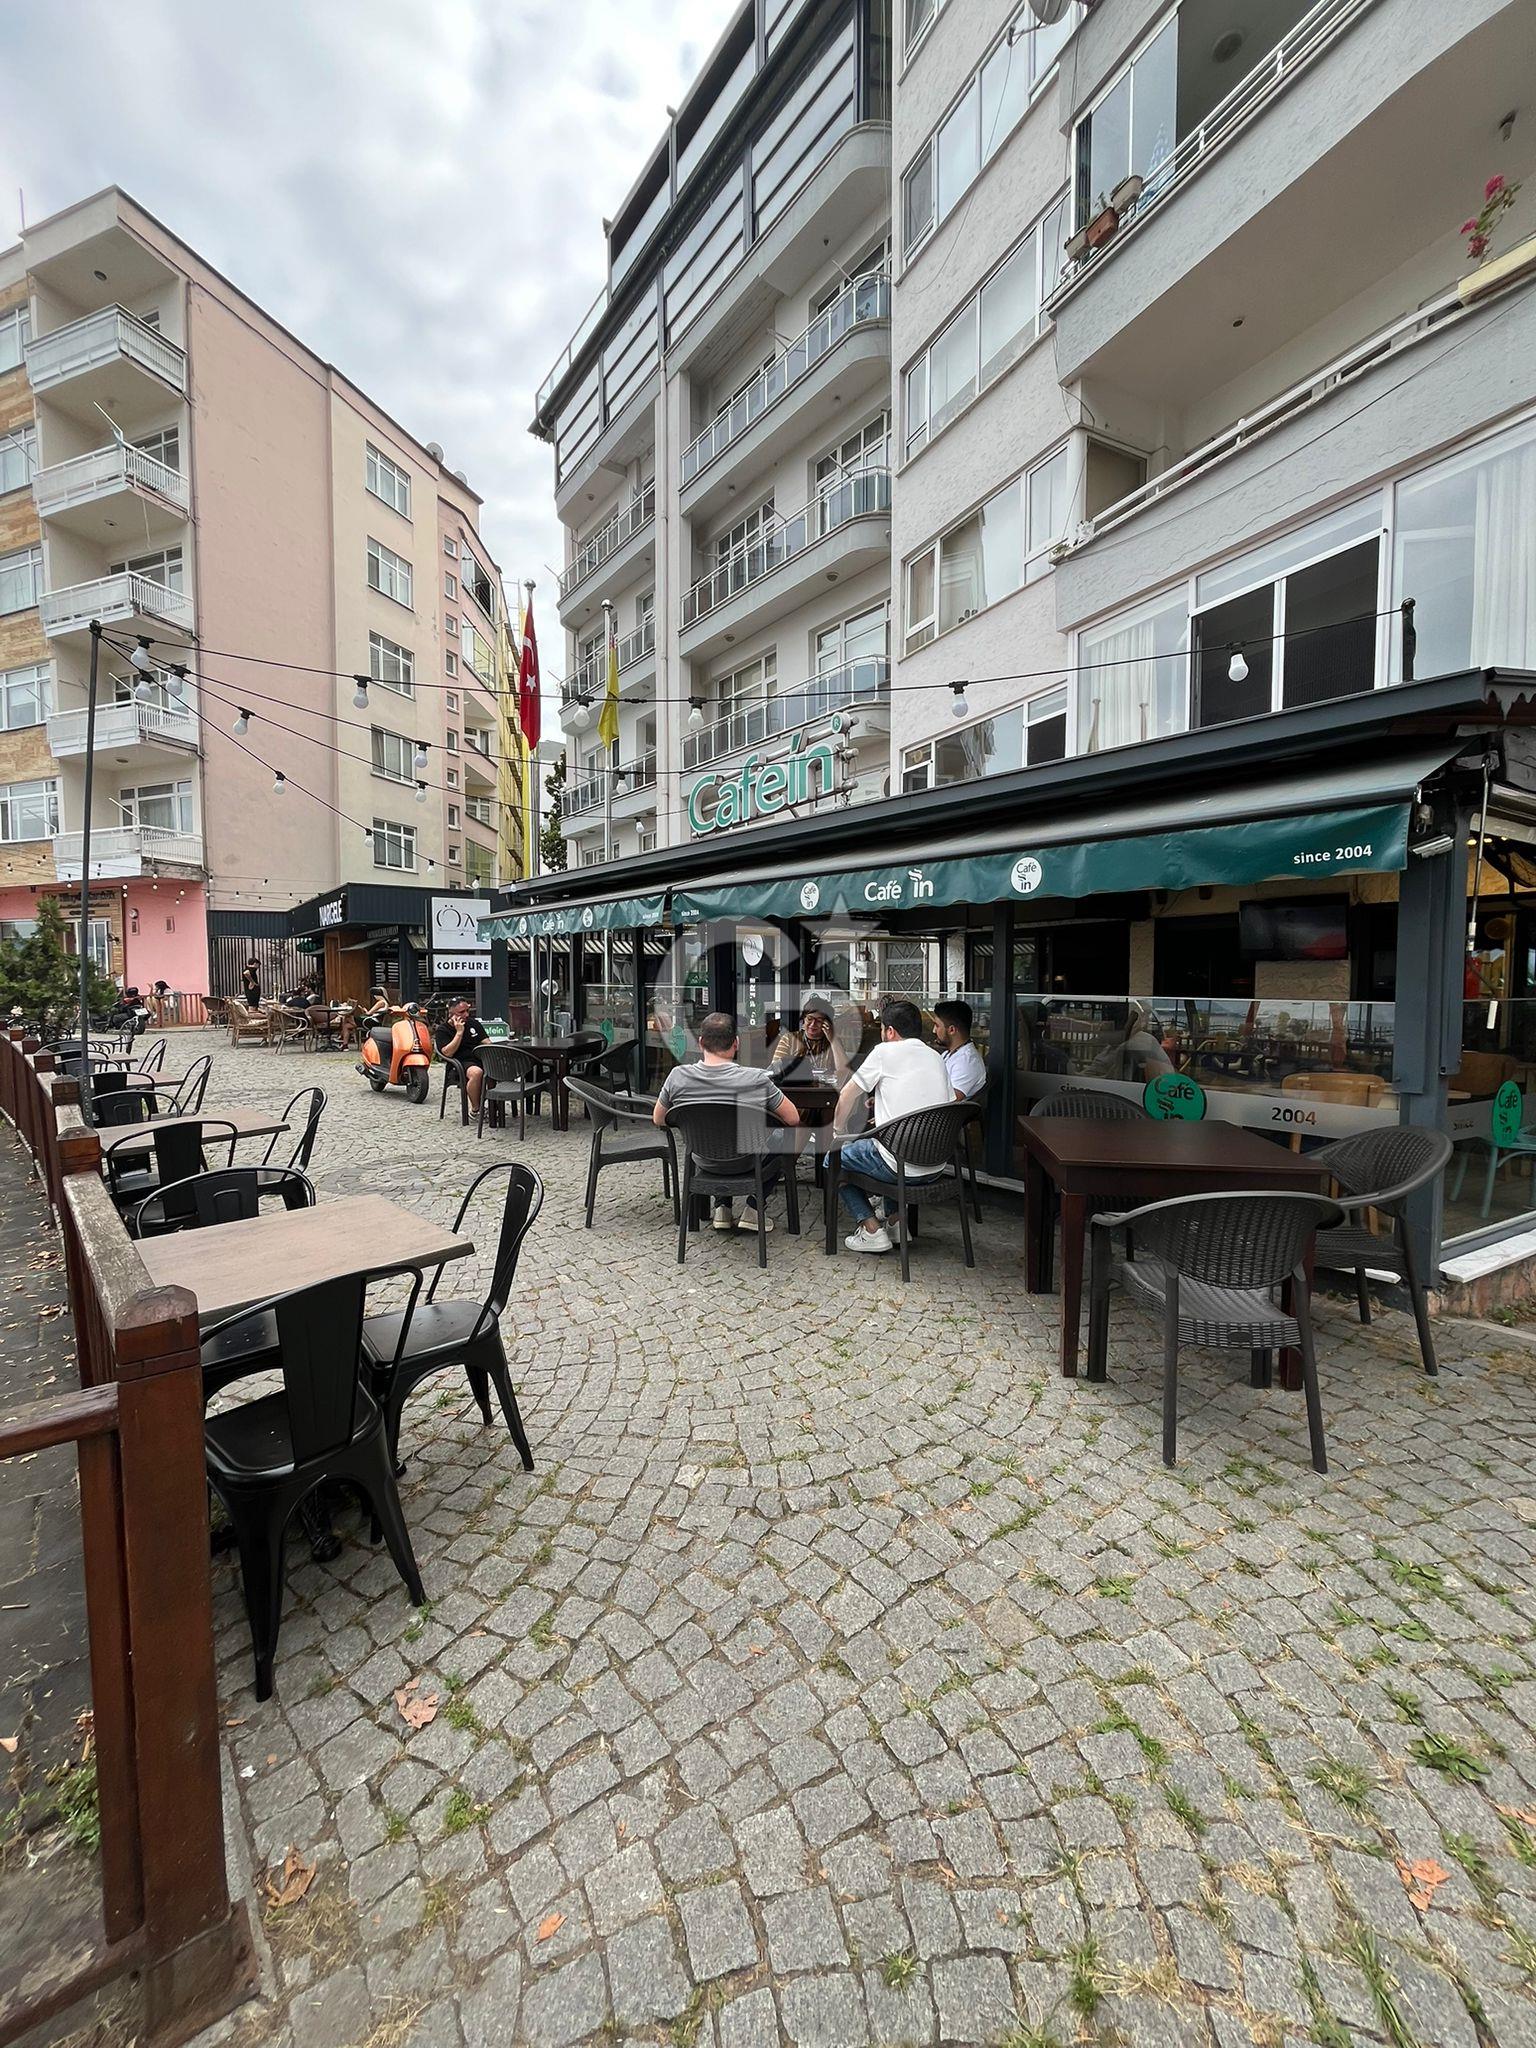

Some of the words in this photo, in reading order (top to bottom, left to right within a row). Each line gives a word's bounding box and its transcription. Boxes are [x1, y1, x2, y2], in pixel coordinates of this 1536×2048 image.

[1294, 852, 1331, 864] since
[1335, 844, 1373, 860] 2004
[1016, 862, 1037, 874] Café
[864, 880, 902, 902] Café
[910, 873, 934, 898] in
[1020, 878, 1031, 891] in
[437, 961, 489, 971] COIFFURE
[1155, 1078, 1195, 1101] Café
[1271, 1107, 1317, 1126] 2004
